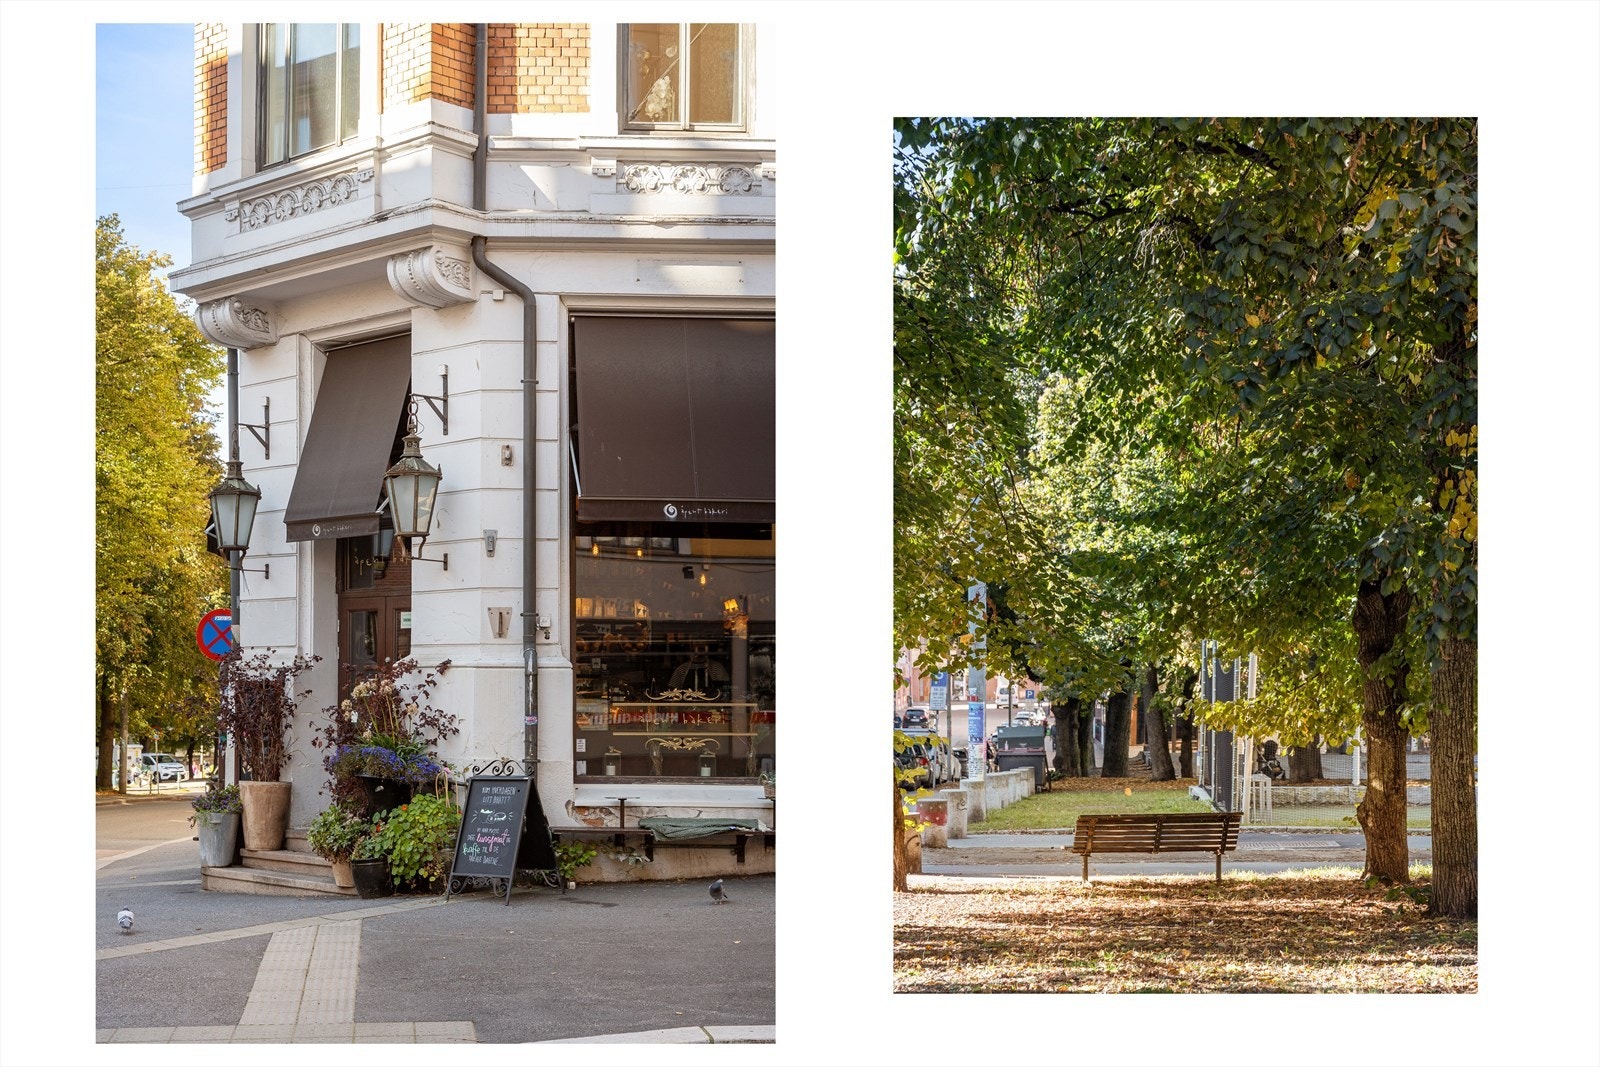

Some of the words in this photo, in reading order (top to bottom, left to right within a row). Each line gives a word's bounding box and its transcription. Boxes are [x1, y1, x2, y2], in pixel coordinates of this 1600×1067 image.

[704, 507, 728, 515] bakeri
[683, 708, 726, 727] bakeri
[463, 843, 480, 856] kaffe
